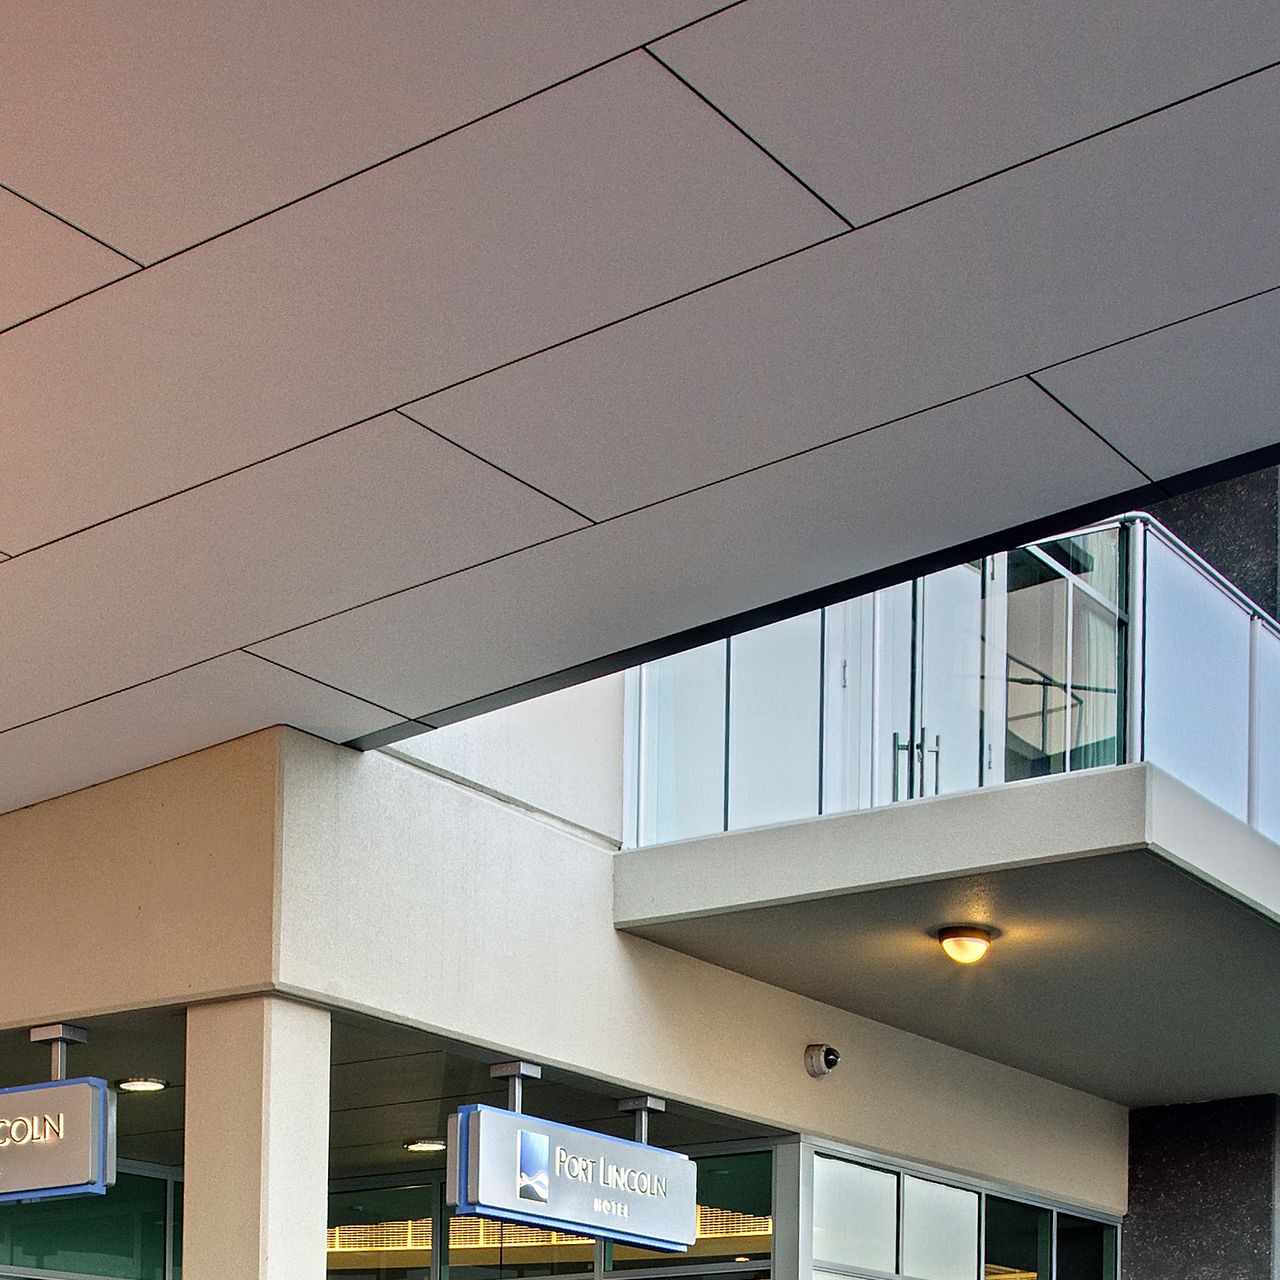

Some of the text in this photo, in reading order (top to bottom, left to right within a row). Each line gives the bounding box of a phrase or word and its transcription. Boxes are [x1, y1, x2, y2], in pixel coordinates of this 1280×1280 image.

[555, 1146, 667, 1199] PORT LINCOLN
[594, 1198, 630, 1218] HOTEL
